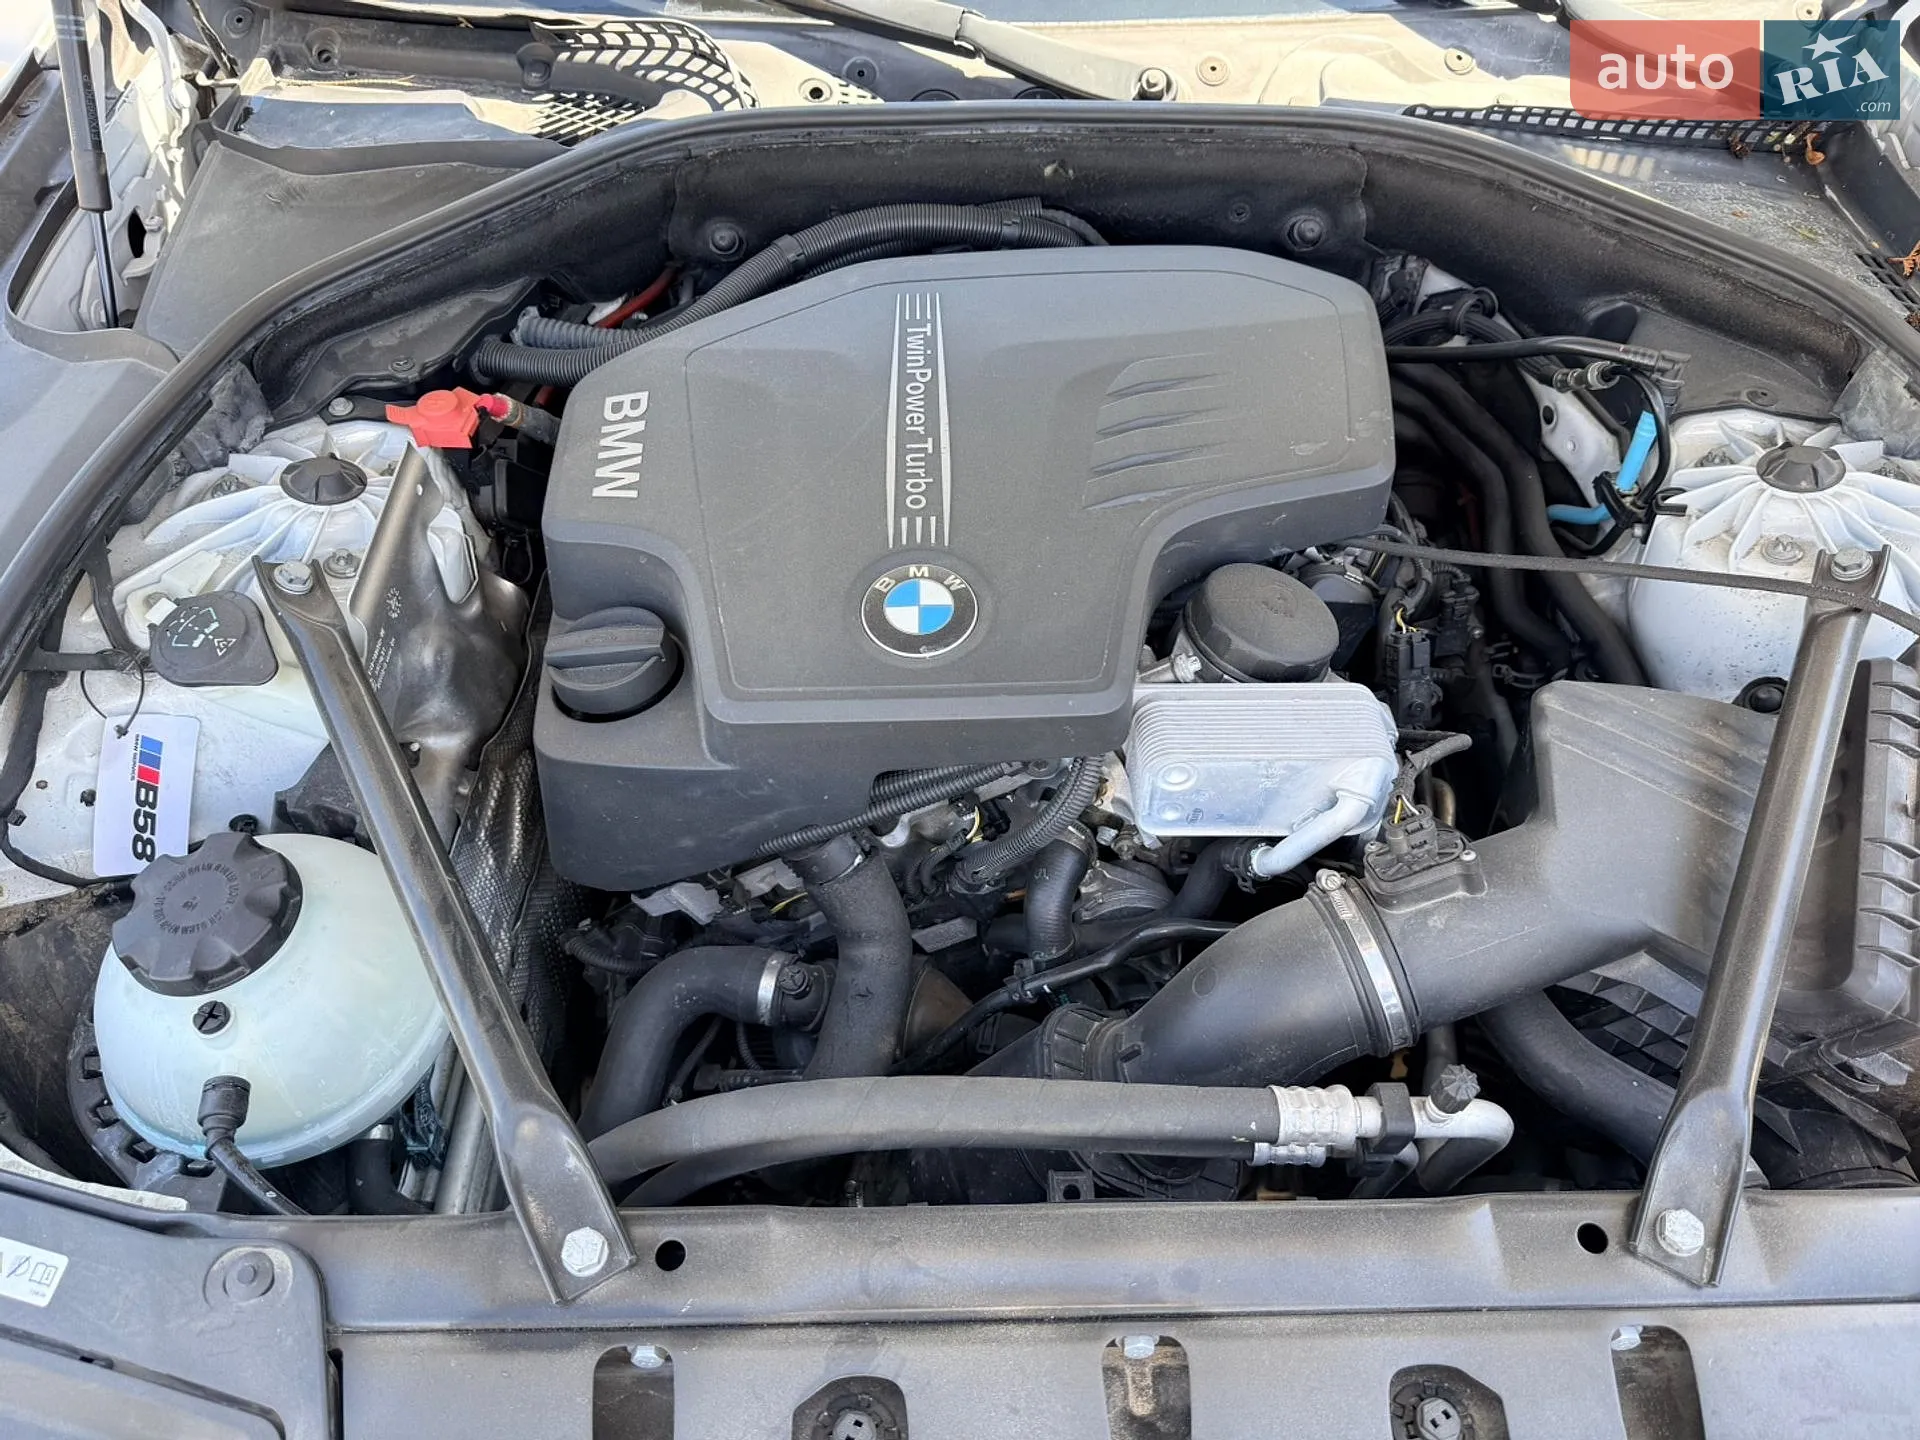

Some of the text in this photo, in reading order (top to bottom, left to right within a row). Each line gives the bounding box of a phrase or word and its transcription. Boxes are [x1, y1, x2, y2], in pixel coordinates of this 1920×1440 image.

[592, 391, 649, 498] BMW
[905, 323, 934, 509] TwinPower Turbo
[875, 566, 966, 593] BMW
[132, 779, 159, 862] B58
